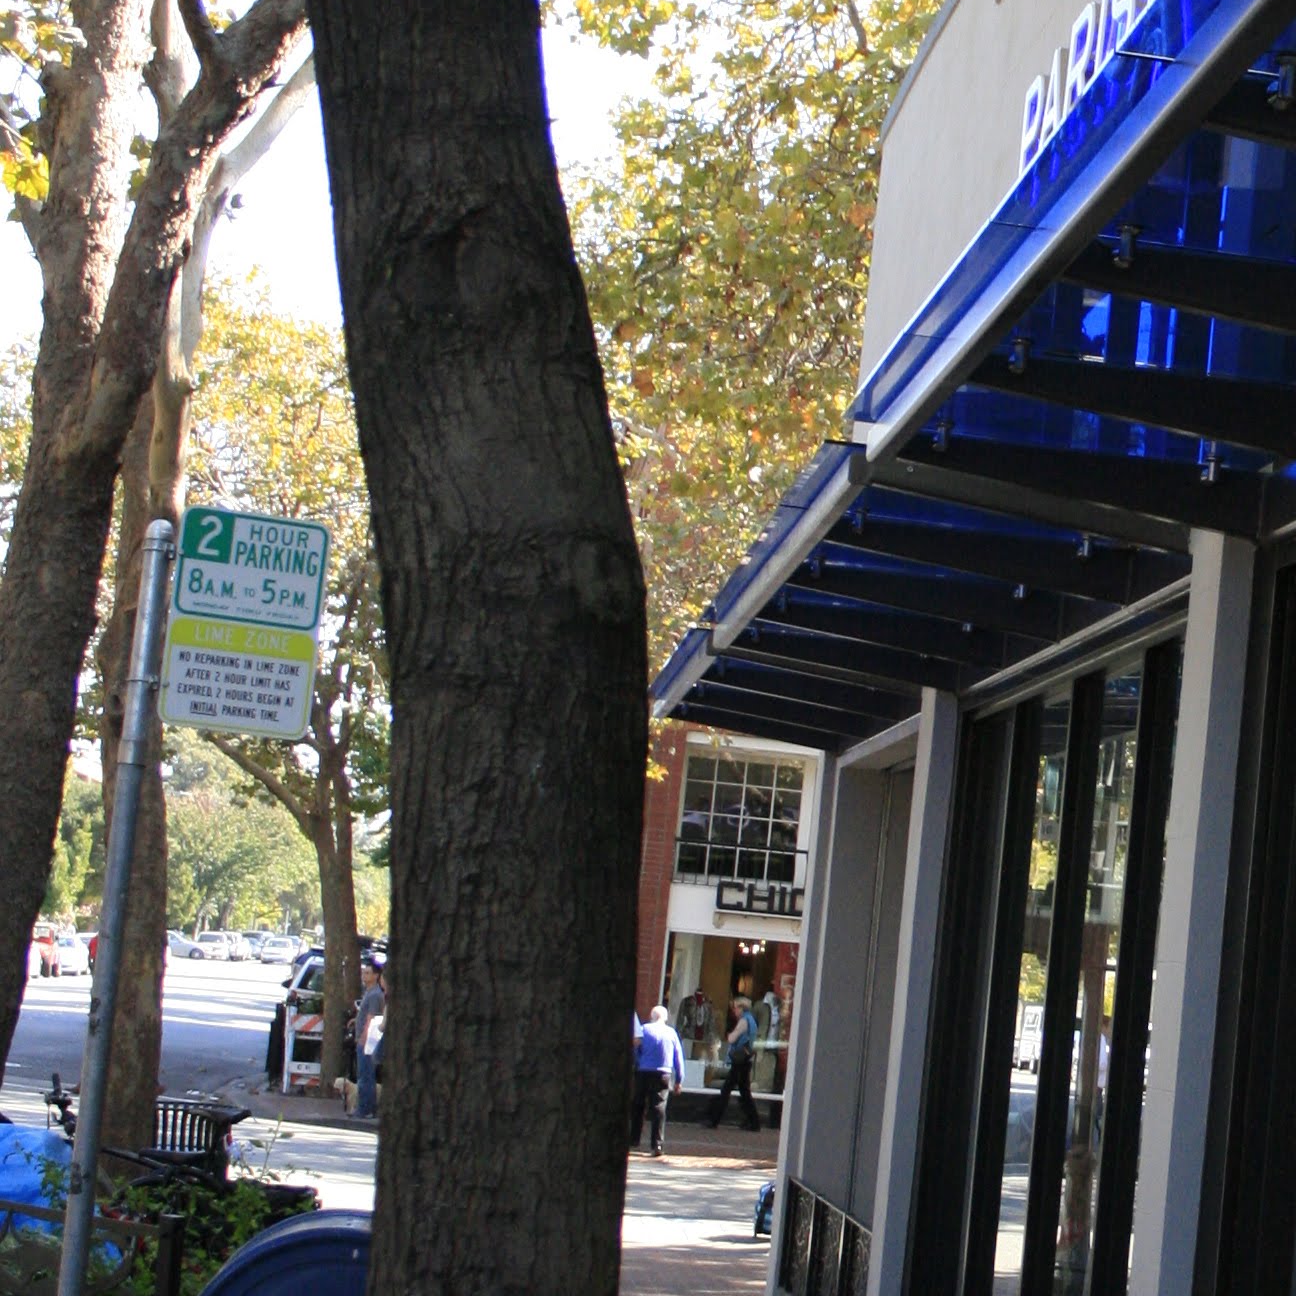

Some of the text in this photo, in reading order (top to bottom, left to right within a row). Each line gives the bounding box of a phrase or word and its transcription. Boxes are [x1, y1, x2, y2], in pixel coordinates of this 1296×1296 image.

[197, 515, 223, 556] 2
[250, 524, 309, 549] HOUR
[234, 541, 319, 577] PARKING
[244, 587, 256, 598] TO
[194, 624, 291, 654] LIME ZONE
[179, 651, 300, 677] NO REPARKING IN LIME ZONE
[186, 668, 291, 691] AFTER 2 HOUR LIMIT HAS
[190, 700, 217, 715] INITIAL
[222, 704, 256, 719] PARKING
[216, 687, 222, 698] 2
[225, 689, 253, 702] HOURS
[257, 693, 281, 705] BEGIN
[285, 697, 295, 707] AT
